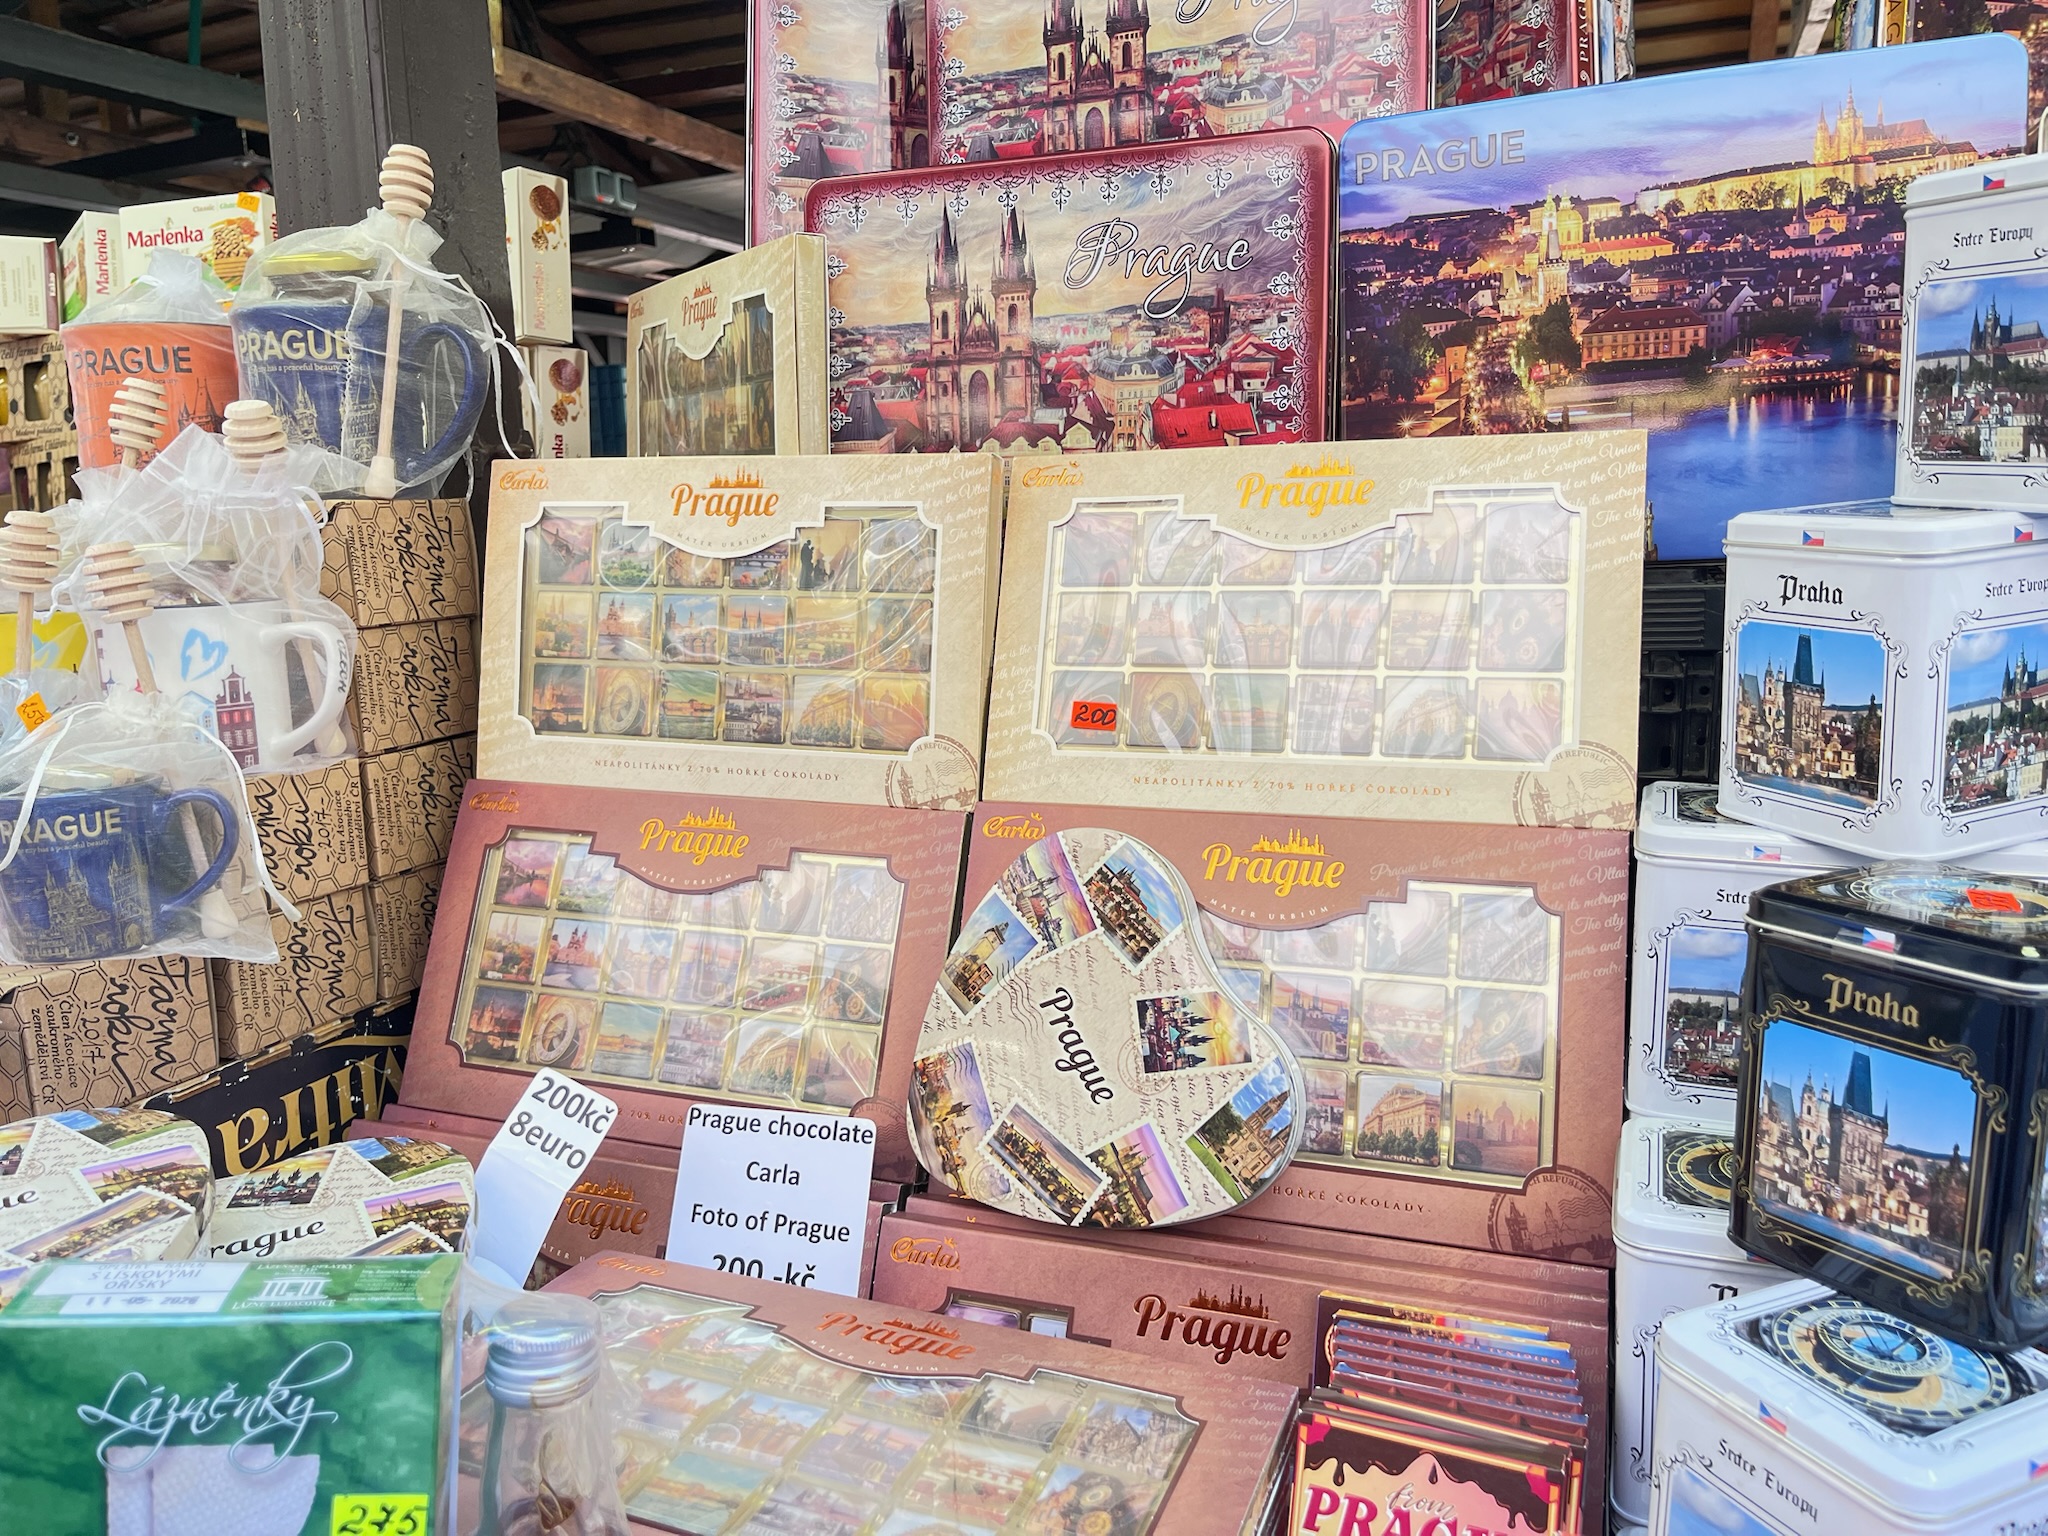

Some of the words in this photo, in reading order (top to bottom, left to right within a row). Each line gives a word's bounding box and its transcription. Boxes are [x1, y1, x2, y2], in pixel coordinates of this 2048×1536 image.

[1354, 130, 1526, 186] PRAGUE
[128, 226, 204, 249] Marlenka
[94, 229, 110, 295] Marlenka
[1064, 218, 1254, 320] Prague
[682, 295, 719, 331] Prague
[41, 342, 64, 354] Cihlá
[72, 346, 193, 377] PRAGUE
[239, 329, 352, 364] PRAGUE
[499, 468, 549, 491] Carla
[1022, 465, 1084, 489] Carla
[1236, 473, 1376, 518] Prague
[671, 483, 780, 528] Prague
[1591, 510, 1621, 529] The
[370, 551, 382, 599] Asociace
[1776, 574, 1844, 606] Praha
[376, 679, 387, 725] Asociace
[1074, 704, 1117, 726] 200
[1565, 750, 1611, 767] REPUBLIC
[333, 790, 346, 837] Asociace
[982, 815, 1046, 841] Carla
[639, 818, 750, 866] Prague
[1201, 842, 1346, 898] Prague
[1210, 898, 1256, 919] MATER
[1268, 904, 1330, 921] URBIUM
[1716, 888, 1749, 905] Srdc
[1570, 916, 1601, 935] The
[1604, 912, 1625, 932] city
[1599, 936, 1622, 951] and
[259, 969, 272, 1018] Asociace
[1822, 973, 1921, 1028] Praha
[59, 1000, 75, 1030] Člen
[31, 1008, 51, 1080] zemědělství
[42, 1084, 55, 1105] ČR
[46, 1004, 62, 1080] soukromého
[63, 1033, 79, 1089] Asociace
[1039, 986, 1114, 1105] Prague
[531, 1075, 617, 1135] 200kč
[509, 1111, 587, 1170] 8euro
[689, 1107, 762, 1135] Prague
[768, 1110, 874, 1145] chocolate
[747, 1161, 800, 1187] Carla
[1542, 1174, 1590, 1194] REPUBLIC
[1273, 1185, 1326, 1200] HOŘKÉ
[1335, 1192, 1425, 1214] ČOKOLÁDY
[691, 1203, 739, 1230] Foto
[745, 1209, 768, 1232] of
[774, 1212, 851, 1245] Prague
[890, 1237, 961, 1272] Carla
[816, 1312, 977, 1362] Prague
[1132, 1292, 1293, 1365] Prague
[1718, 1438, 1757, 1476] Srdce
[339, 1504, 430, 1534] 275
[1302, 1484, 1508, 1536] PRA
[1388, 1482, 1456, 1523] from
